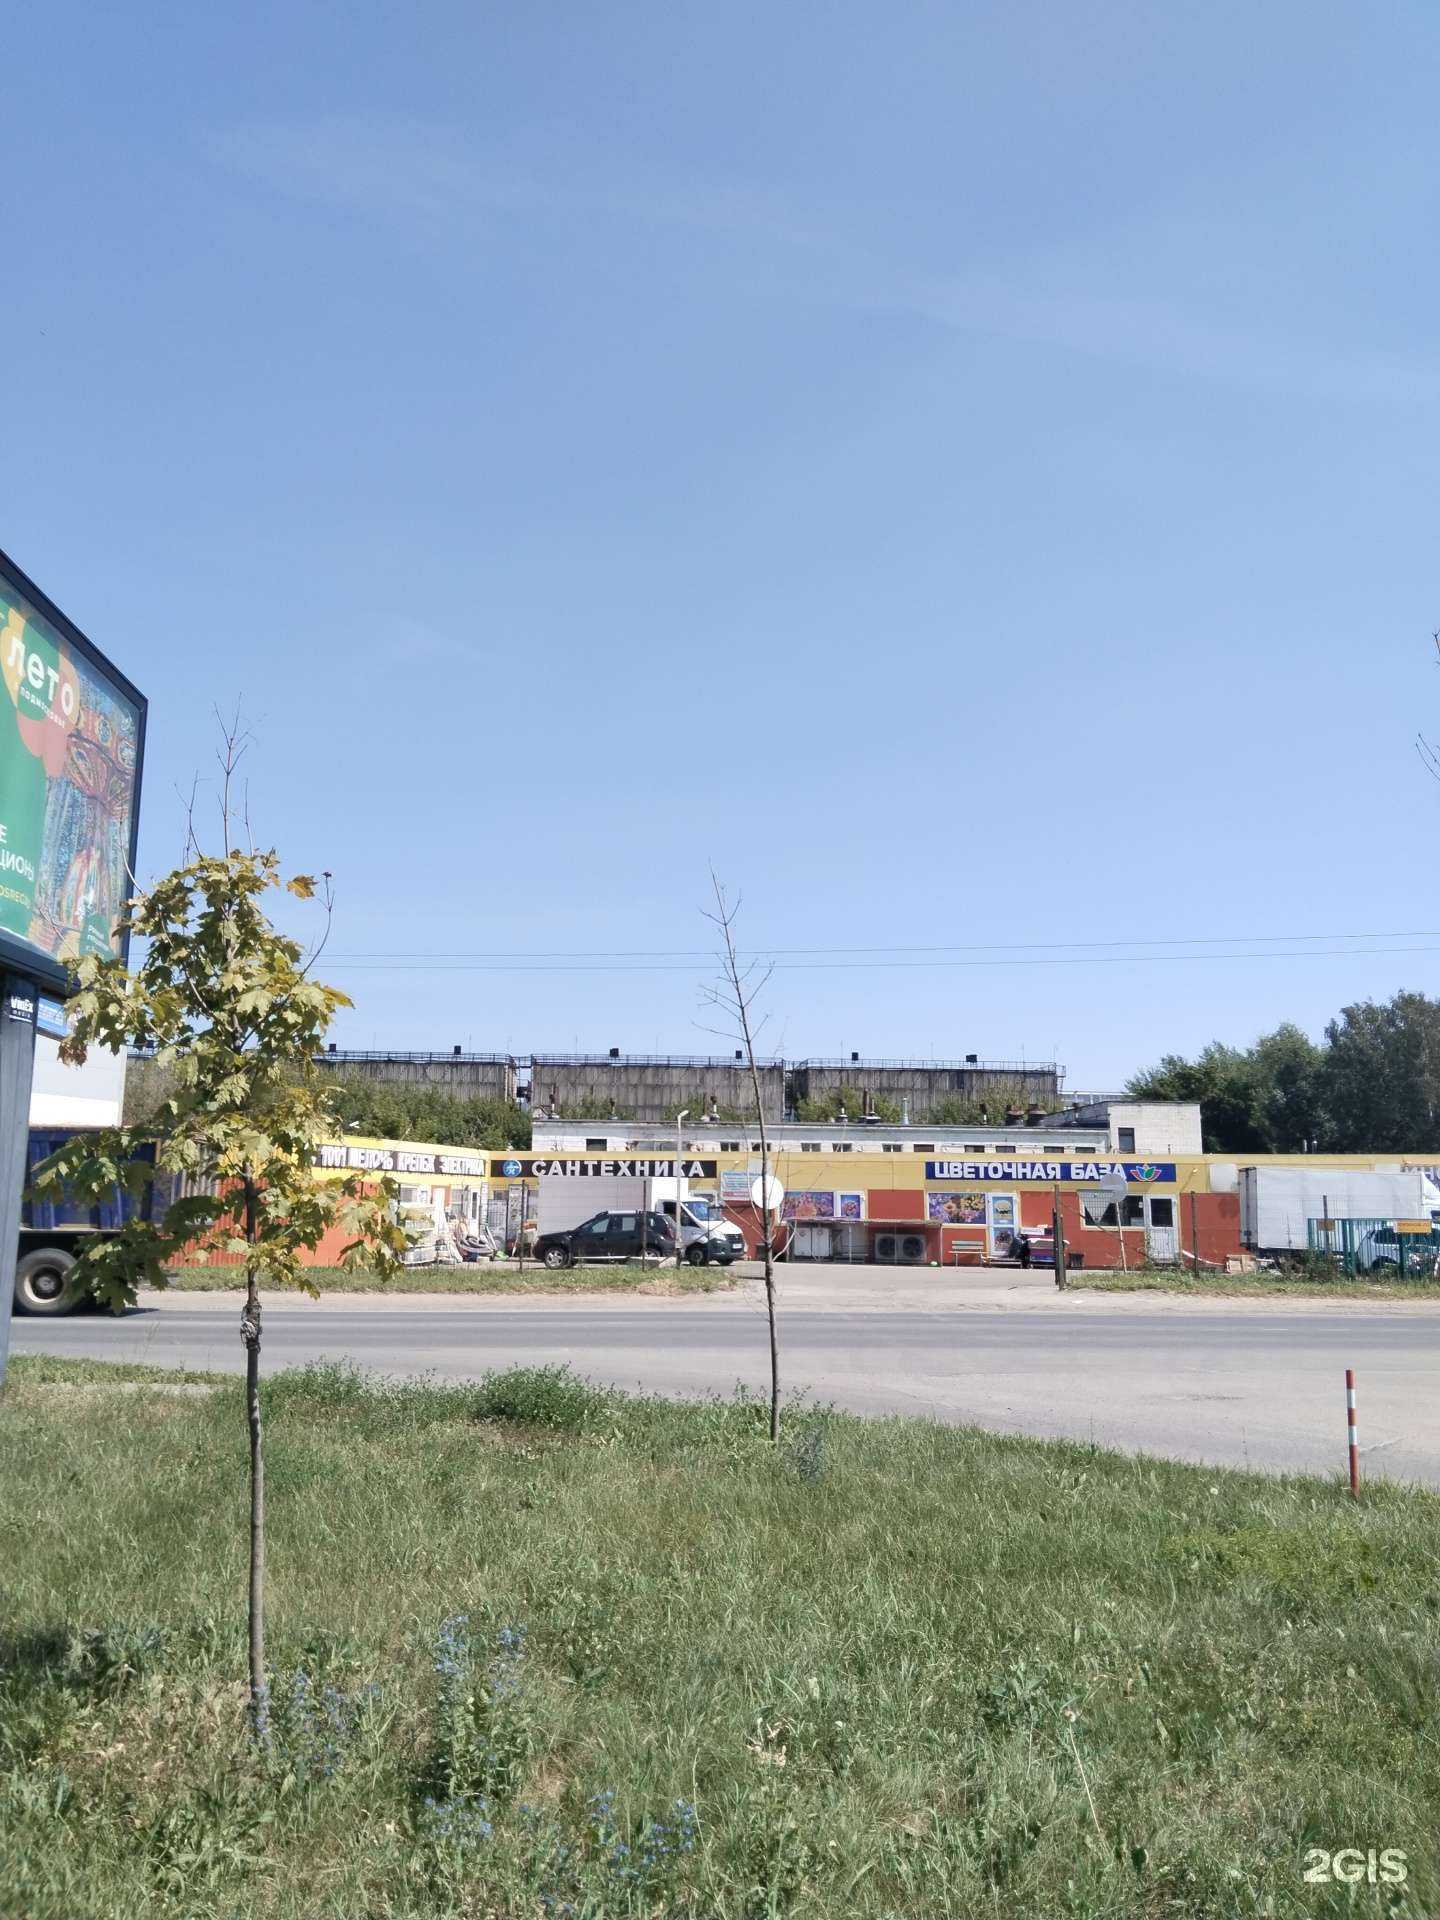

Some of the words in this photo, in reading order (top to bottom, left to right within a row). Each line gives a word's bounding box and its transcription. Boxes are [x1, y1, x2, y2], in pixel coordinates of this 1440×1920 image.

[531, 1160, 706, 1177] САНТЕХНИКА
[934, 1162, 1061, 1179] ЦВЕТОЧНАЯ
[1070, 1163, 1127, 1180] БАЗА
